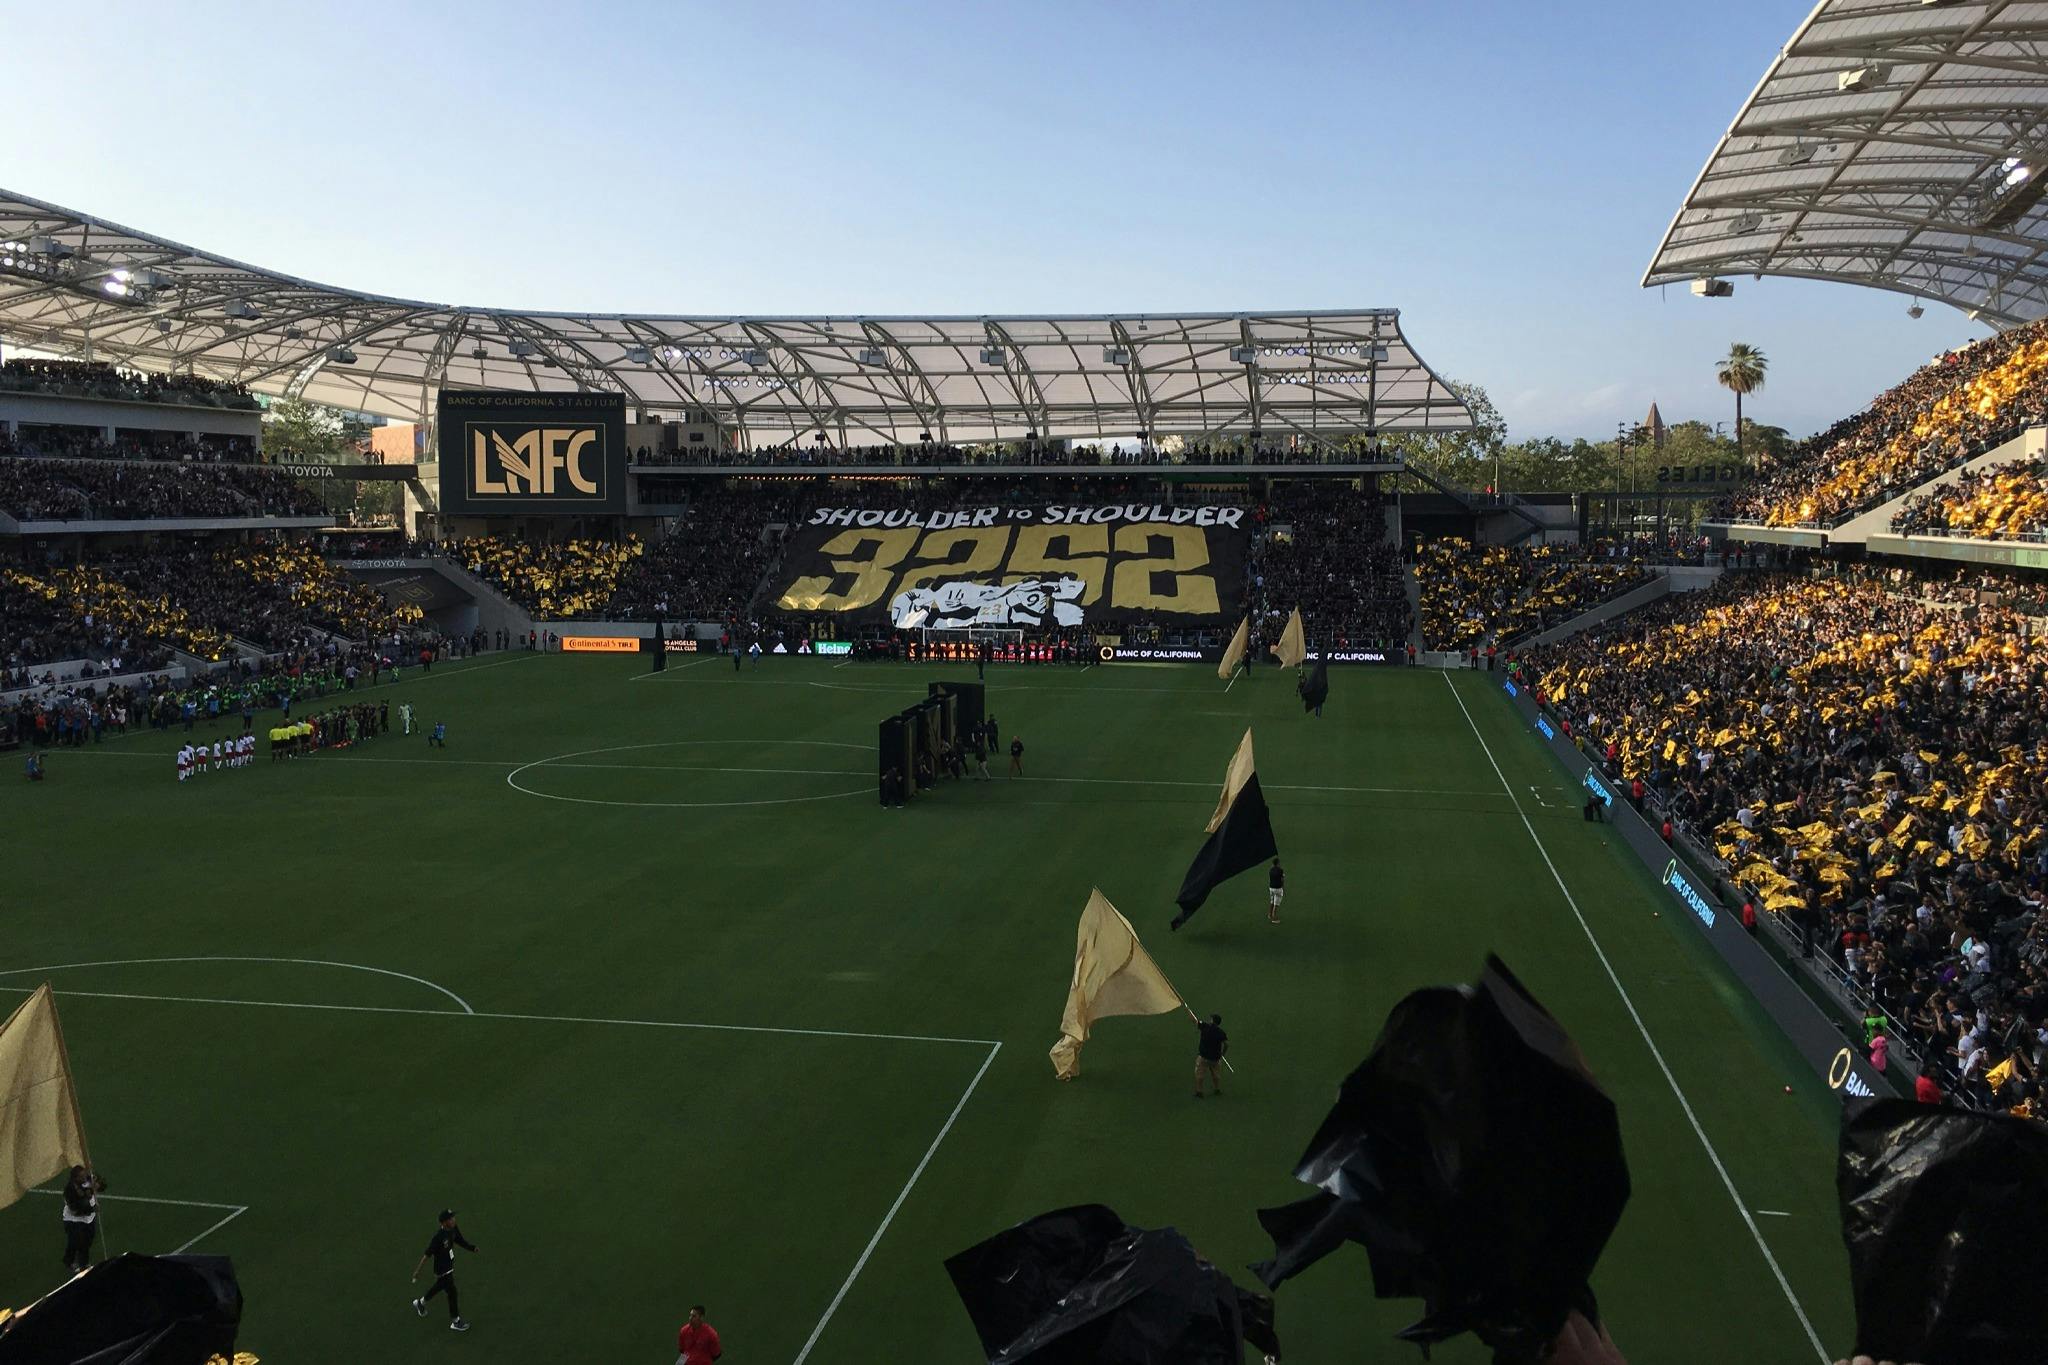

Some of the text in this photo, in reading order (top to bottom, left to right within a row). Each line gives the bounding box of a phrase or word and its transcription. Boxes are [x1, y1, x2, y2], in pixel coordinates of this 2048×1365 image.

[447, 397, 618, 407] BANC OF CALIFORNIA STADIUM
[474, 428, 597, 495] LAFC
[288, 466, 334, 477] TOYOTA
[808, 506, 999, 530] SHOULDER
[1041, 506, 1244, 530] SHOULDER
[368, 560, 408, 568] TOYOTA
[777, 523, 1222, 614] 3252
[1026, 593, 1040, 606] 9
[569, 639, 611, 648] Continental
[818, 643, 851, 654] Heine
[1115, 650, 1202, 659] BANC OF CALIFORNIA
[1305, 652, 1319, 660] NC
[1334, 653, 1385, 661] CALIFORNIA
[1688, 890, 1716, 929] CALIFORNIA
[1845, 1071, 1875, 1097] BAN
